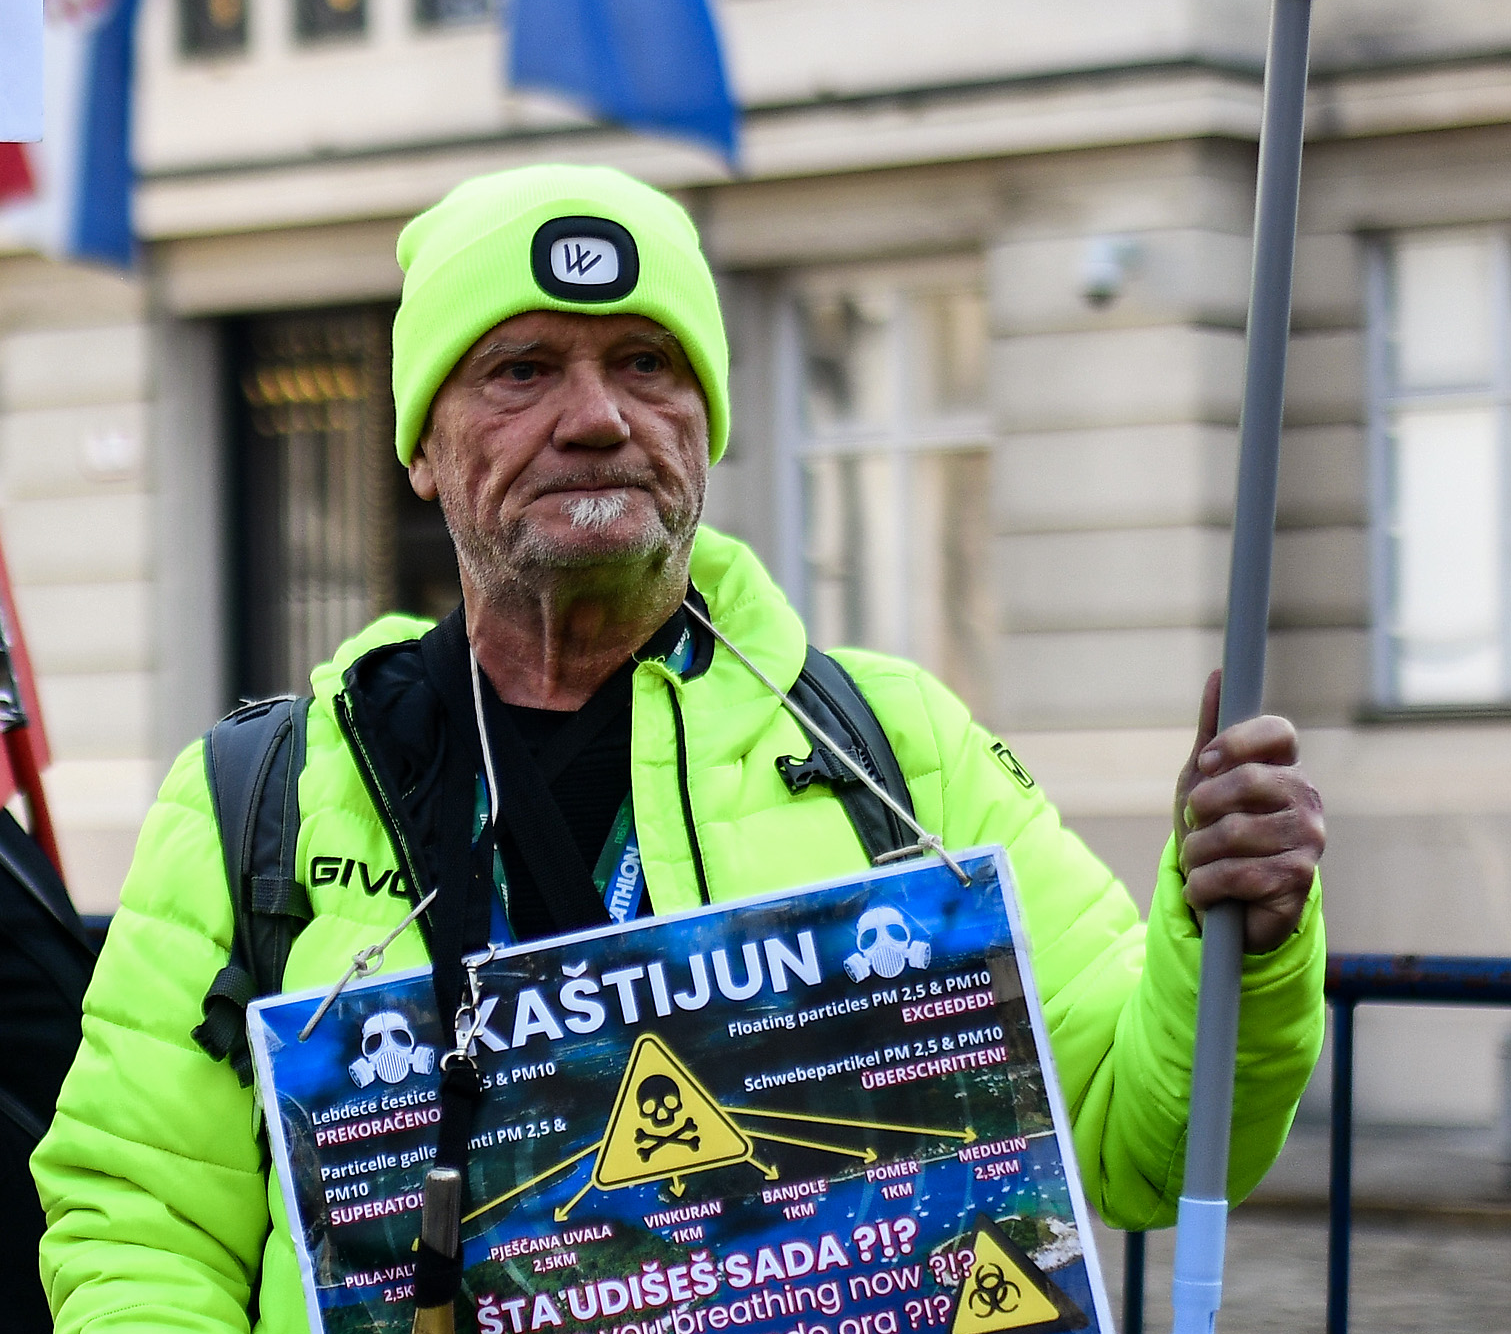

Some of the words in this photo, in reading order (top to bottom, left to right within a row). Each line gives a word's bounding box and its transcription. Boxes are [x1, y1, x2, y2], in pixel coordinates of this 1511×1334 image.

[608, 845, 641, 924] ATHLON
[458, 930, 822, 1058] KAŠTIJUN
[728, 1010, 795, 1038] Floating
[799, 996, 869, 1026] particles
[872, 989, 897, 1007] PM
[901, 984, 927, 1005] 2,5
[930, 981, 943, 996] &
[946, 971, 991, 993] PM10
[902, 992, 995, 1023] EXCEEDED!
[744, 1051, 880, 1092] Schwebepartikel
[883, 1044, 910, 1064] PM
[913, 1040, 938, 1059] 2,5
[941, 1036, 955, 1051] &
[957, 1026, 1003, 1048] PM10
[861, 1047, 1007, 1091] ÜBERSCHRITTEN!
[381, 1090, 436, 1110] čestice
[497, 1074, 509, 1087] &
[512, 1062, 556, 1082] PM10
[321, 1154, 397, 1182] Particelle
[497, 1126, 523, 1144] PM
[526, 1121, 550, 1139] 2,5
[554, 1118, 567, 1132] &
[958, 1138, 1027, 1163] MEDULIN
[866, 1161, 919, 1183] POMER
[974, 1159, 1019, 1181] 2,5KM
[325, 1182, 369, 1204] PM10
[762, 1179, 827, 1204] BANJOLE
[881, 1182, 913, 1201] 1KM
[331, 1193, 424, 1226] SUPERATO!
[643, 1202, 722, 1230] VINKURAN
[782, 1202, 815, 1221] 1KM
[563, 1225, 612, 1247] UVALA
[672, 1226, 703, 1245] 1KM
[345, 1263, 416, 1288] PULA-VAL
[533, 1252, 577, 1273] 2,5KM
[566, 1251, 718, 1322] UDIŠEŠ
[725, 1235, 848, 1288] SADA
[853, 1218, 918, 1262] ?!?
[849, 1265, 921, 1302] now
[929, 1249, 977, 1283] ?!?
[384, 1285, 415, 1302] 2,5K
[905, 1295, 952, 1329] ?!?
